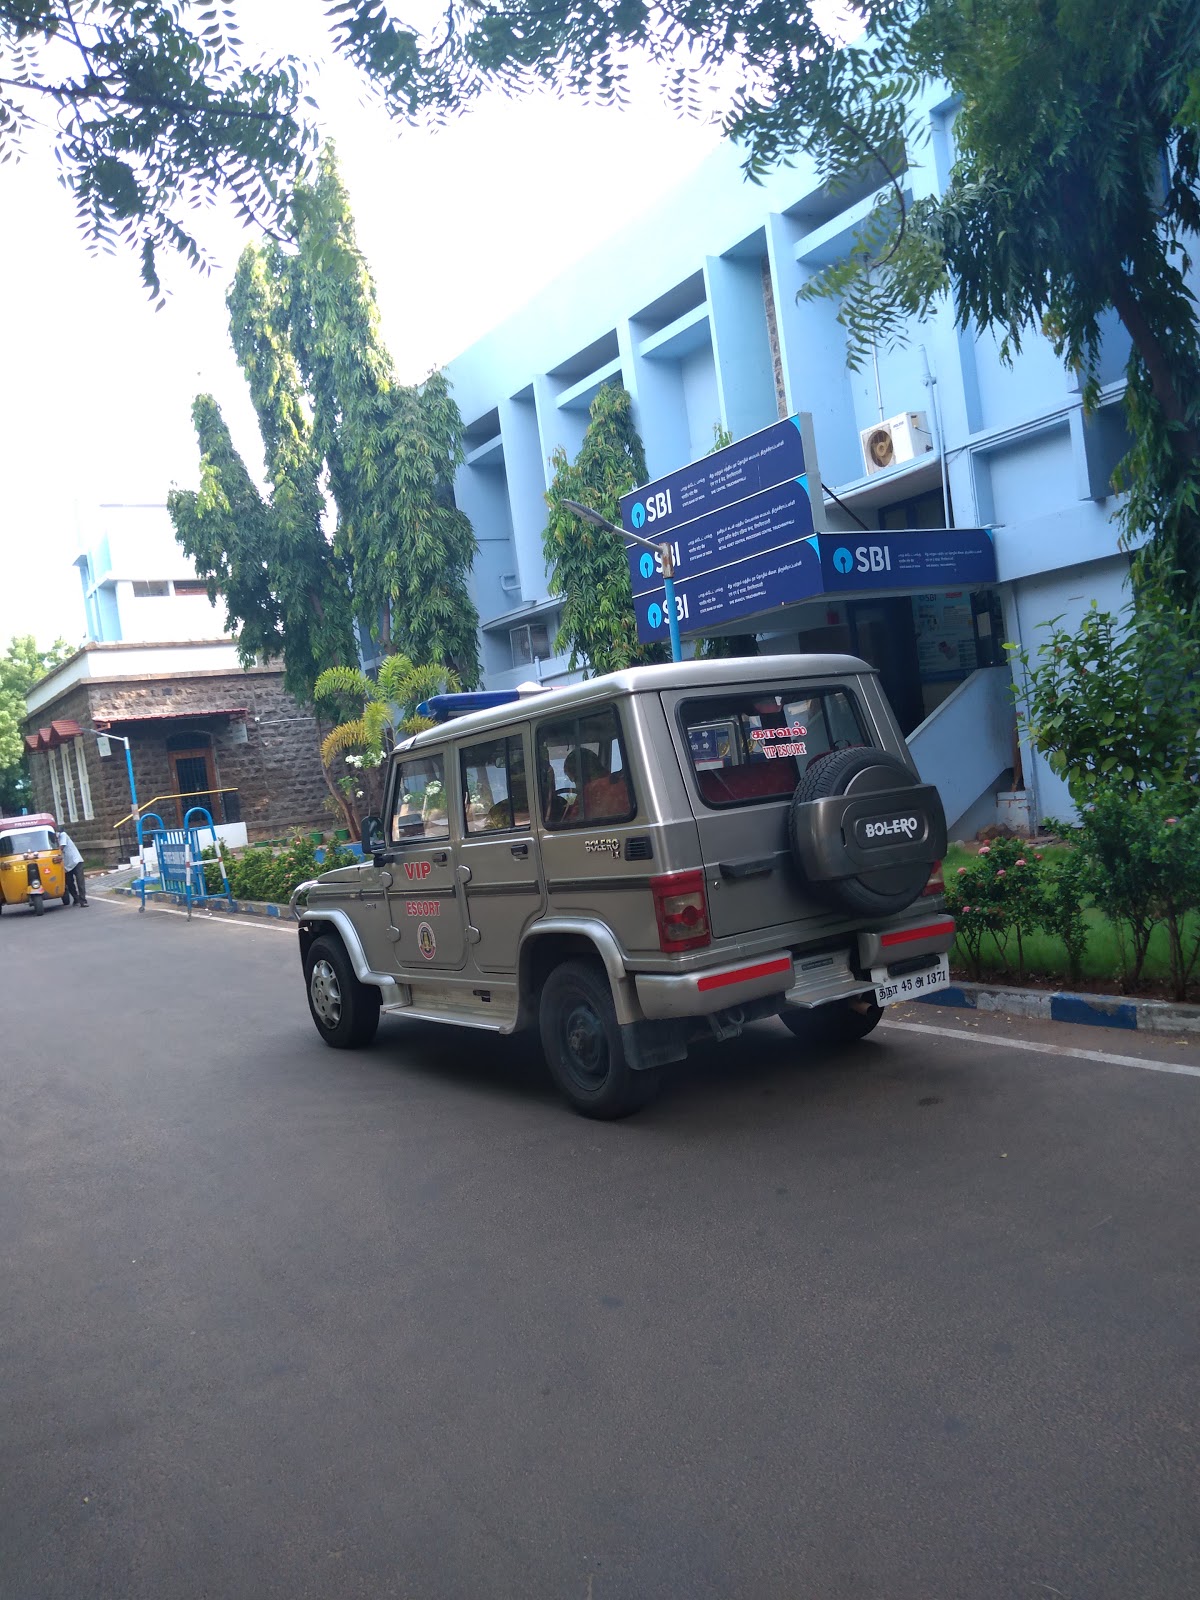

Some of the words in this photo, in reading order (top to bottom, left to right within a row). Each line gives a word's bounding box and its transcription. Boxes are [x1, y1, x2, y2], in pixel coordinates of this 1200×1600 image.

[646, 488, 672, 522] SBI
[855, 545, 891, 573] SBI
[751, 721, 807, 740] காவல்
[763, 746, 777, 759] VIP
[778, 742, 807, 757] ESCORT
[865, 817, 918, 838] BOLERO
[585, 838, 619, 852] BOLERO
[404, 861, 431, 880] VIP
[406, 901, 440, 916] ESCORT
[901, 979, 913, 991] 45
[926, 970, 946, 985] 1371
